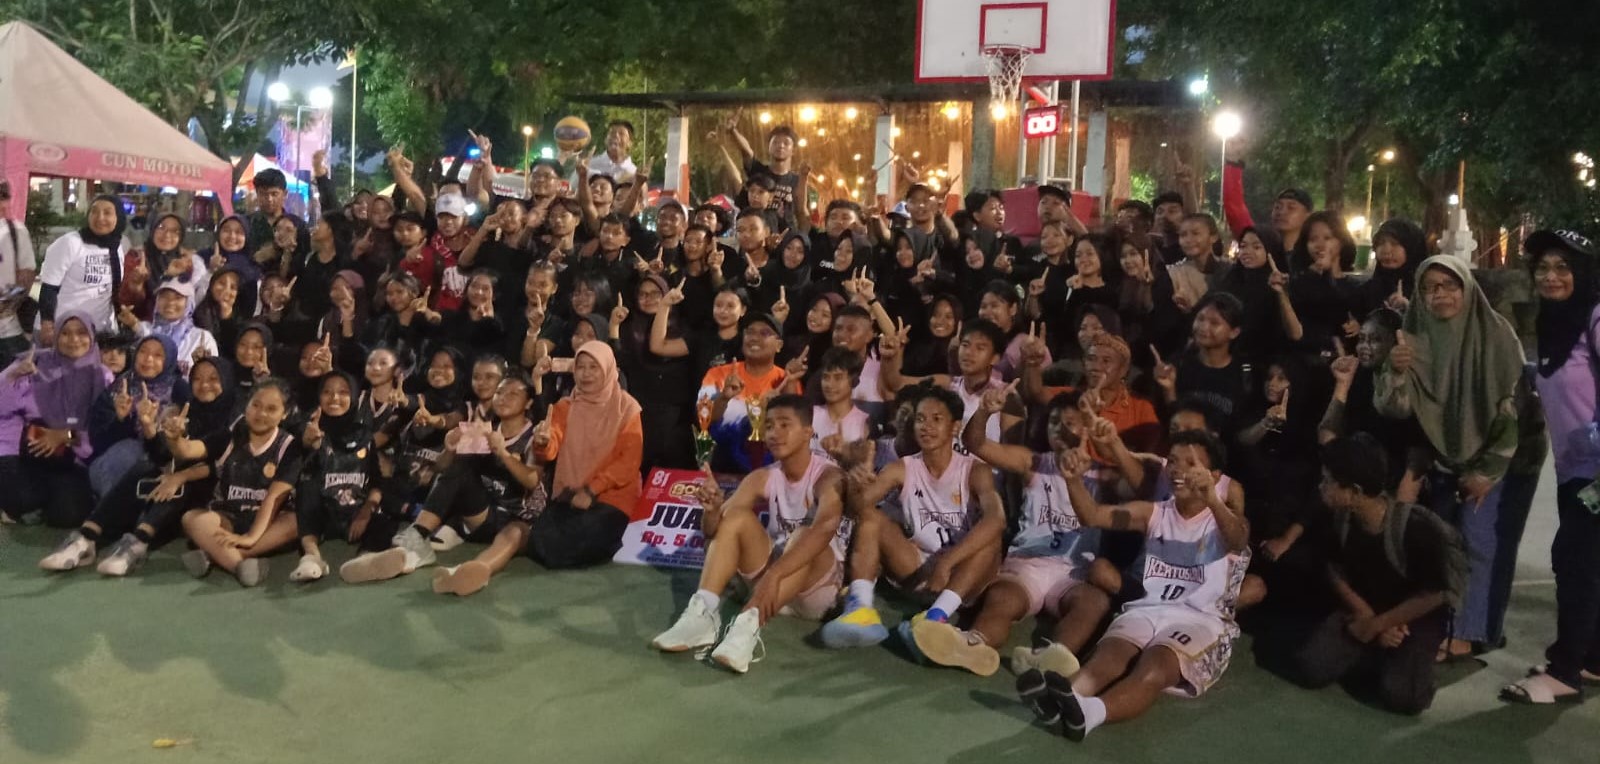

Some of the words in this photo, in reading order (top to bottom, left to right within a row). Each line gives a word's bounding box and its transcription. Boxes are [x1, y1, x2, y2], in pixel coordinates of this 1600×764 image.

[1028, 114, 1056, 134] 00
[102, 152, 137, 169] CUN
[143, 156, 202, 178] MOTOR
[651, 469, 672, 488] 81
[647, 504, 704, 530] JUA
[641, 530, 667, 547] Rp.
[674, 533, 704, 549] 5.0
[936, 531, 954, 548] 11
[1161, 583, 1186, 601] 10
[1168, 630, 1193, 646] 10
